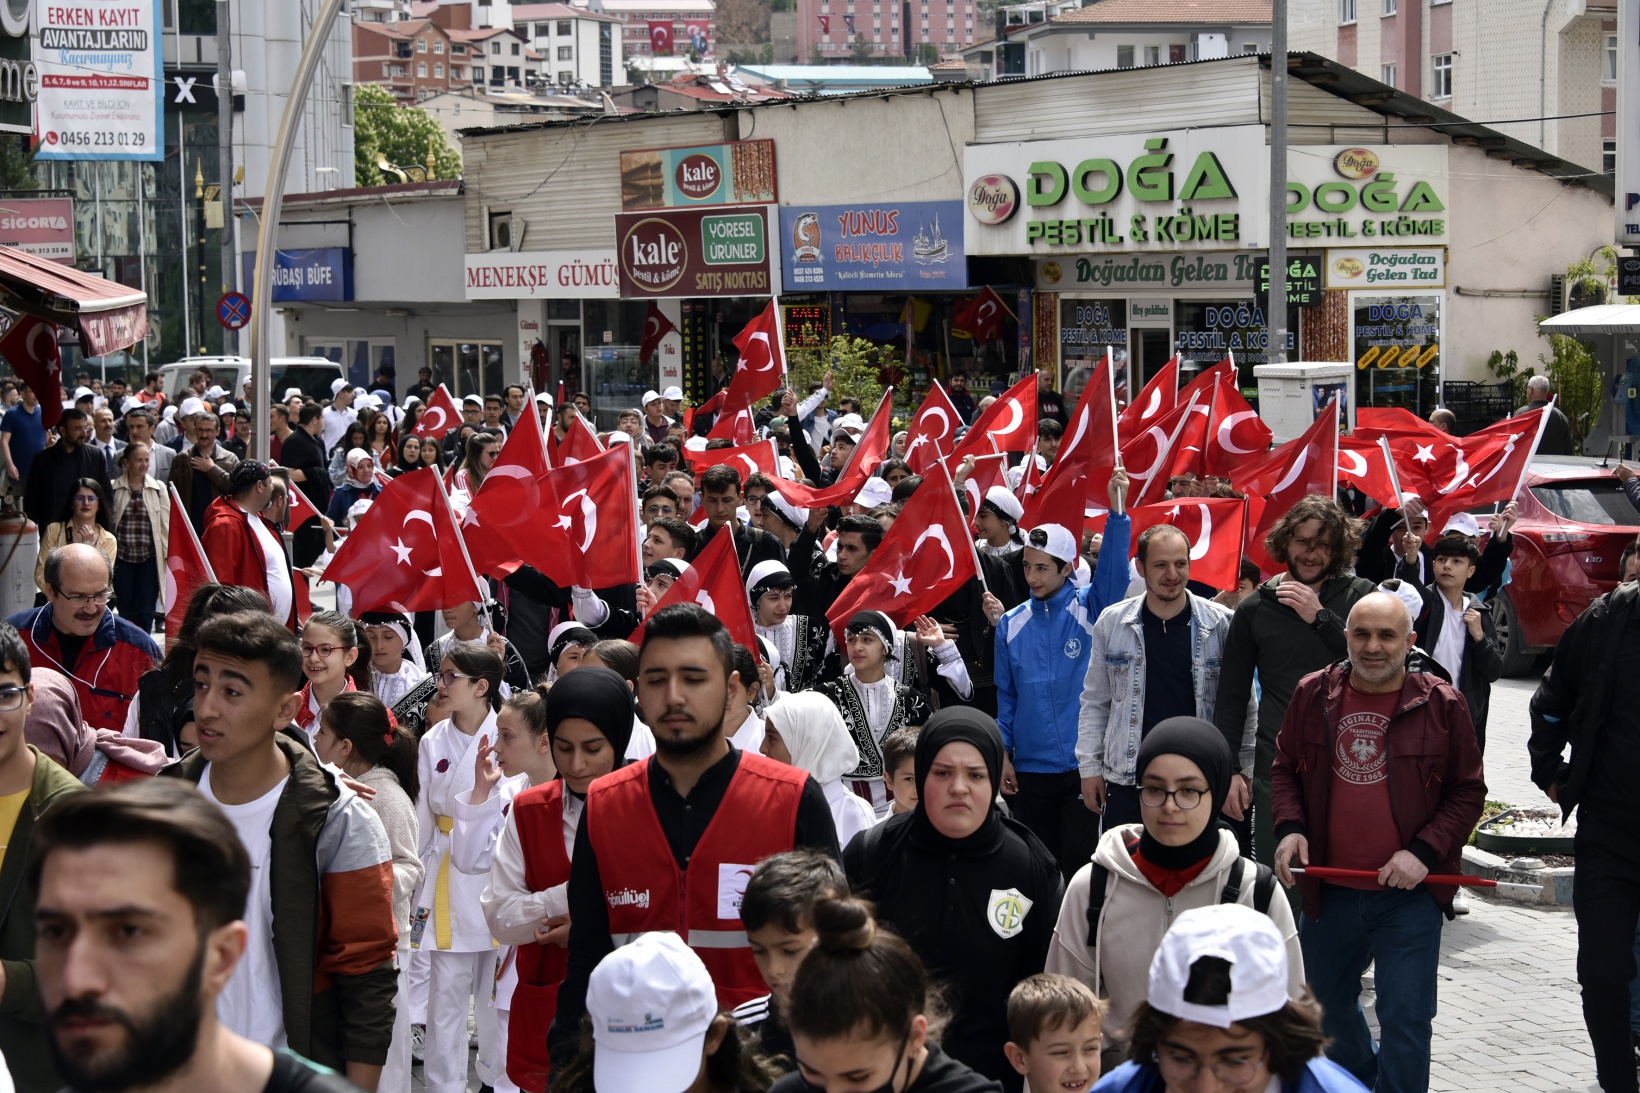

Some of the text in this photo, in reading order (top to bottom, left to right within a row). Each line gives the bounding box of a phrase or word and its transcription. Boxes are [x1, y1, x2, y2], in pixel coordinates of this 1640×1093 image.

[48, 7, 93, 26] ERKEN
[100, 8, 140, 26] KAYIT
[43, 30, 146, 49] AVANTAJLARINI
[58, 48, 133, 70] Kaçırmayınız
[64, 100, 84, 108] KAYIT
[87, 100, 95, 108] VE
[61, 132, 145, 146] 0456 213 01 29
[682, 162, 714, 182] kale
[1027, 138, 1238, 206] DOĞA
[1342, 155, 1373, 171] Doğa
[973, 184, 1007, 212] Doğa
[1287, 173, 1446, 213] DOĞA
[1, 215, 68, 230] SİGORTA
[709, 221, 755, 238] YÖRESEL
[838, 210, 899, 238] YUNUS
[1026, 208, 1239, 244] PESTİL & KÖME
[1362, 219, 1377, 236] &
[1381, 216, 1445, 235] KÖME
[632, 234, 679, 265] kale
[710, 242, 757, 259] ÜRÜNLER
[835, 243, 904, 268] BALIKÇILIK
[1261, 260, 1316, 278] DĞA
[1336, 262, 1359, 274] Doğa
[1369, 253, 1436, 267] Doğadan
[308, 263, 332, 285] BÜFE
[467, 266, 548, 294] MENEKŞE
[633, 266, 680, 284] pestil & köme
[1076, 257, 1164, 287] Doğadan
[1170, 256, 1228, 287] Gelen
[1367, 268, 1438, 283] Gelen Tad
[696, 271, 767, 292] SATIŞ NOKTASI
[1262, 279, 1316, 291] PSTİL
[793, 309, 820, 317] KALE
[1077, 302, 1110, 325] DOĞA
[1133, 305, 1169, 317] Hoş geldiniz
[1206, 302, 1266, 328] DOĞA
[1369, 300, 1423, 321] DOĞA
[520, 320, 538, 332] Gümüş
[1062, 325, 1126, 344] PESTİL & KÖME
[1356, 323, 1436, 337] PESTİL & KÖME
[1179, 328, 1294, 349] PESTİL & KÖE
[664, 344, 675, 354] Toka
[1223, 353, 1245, 363] STIŞ
[1337, 715, 1376, 734] RIGINAL
[1339, 766, 1382, 781] SINCE 1968
